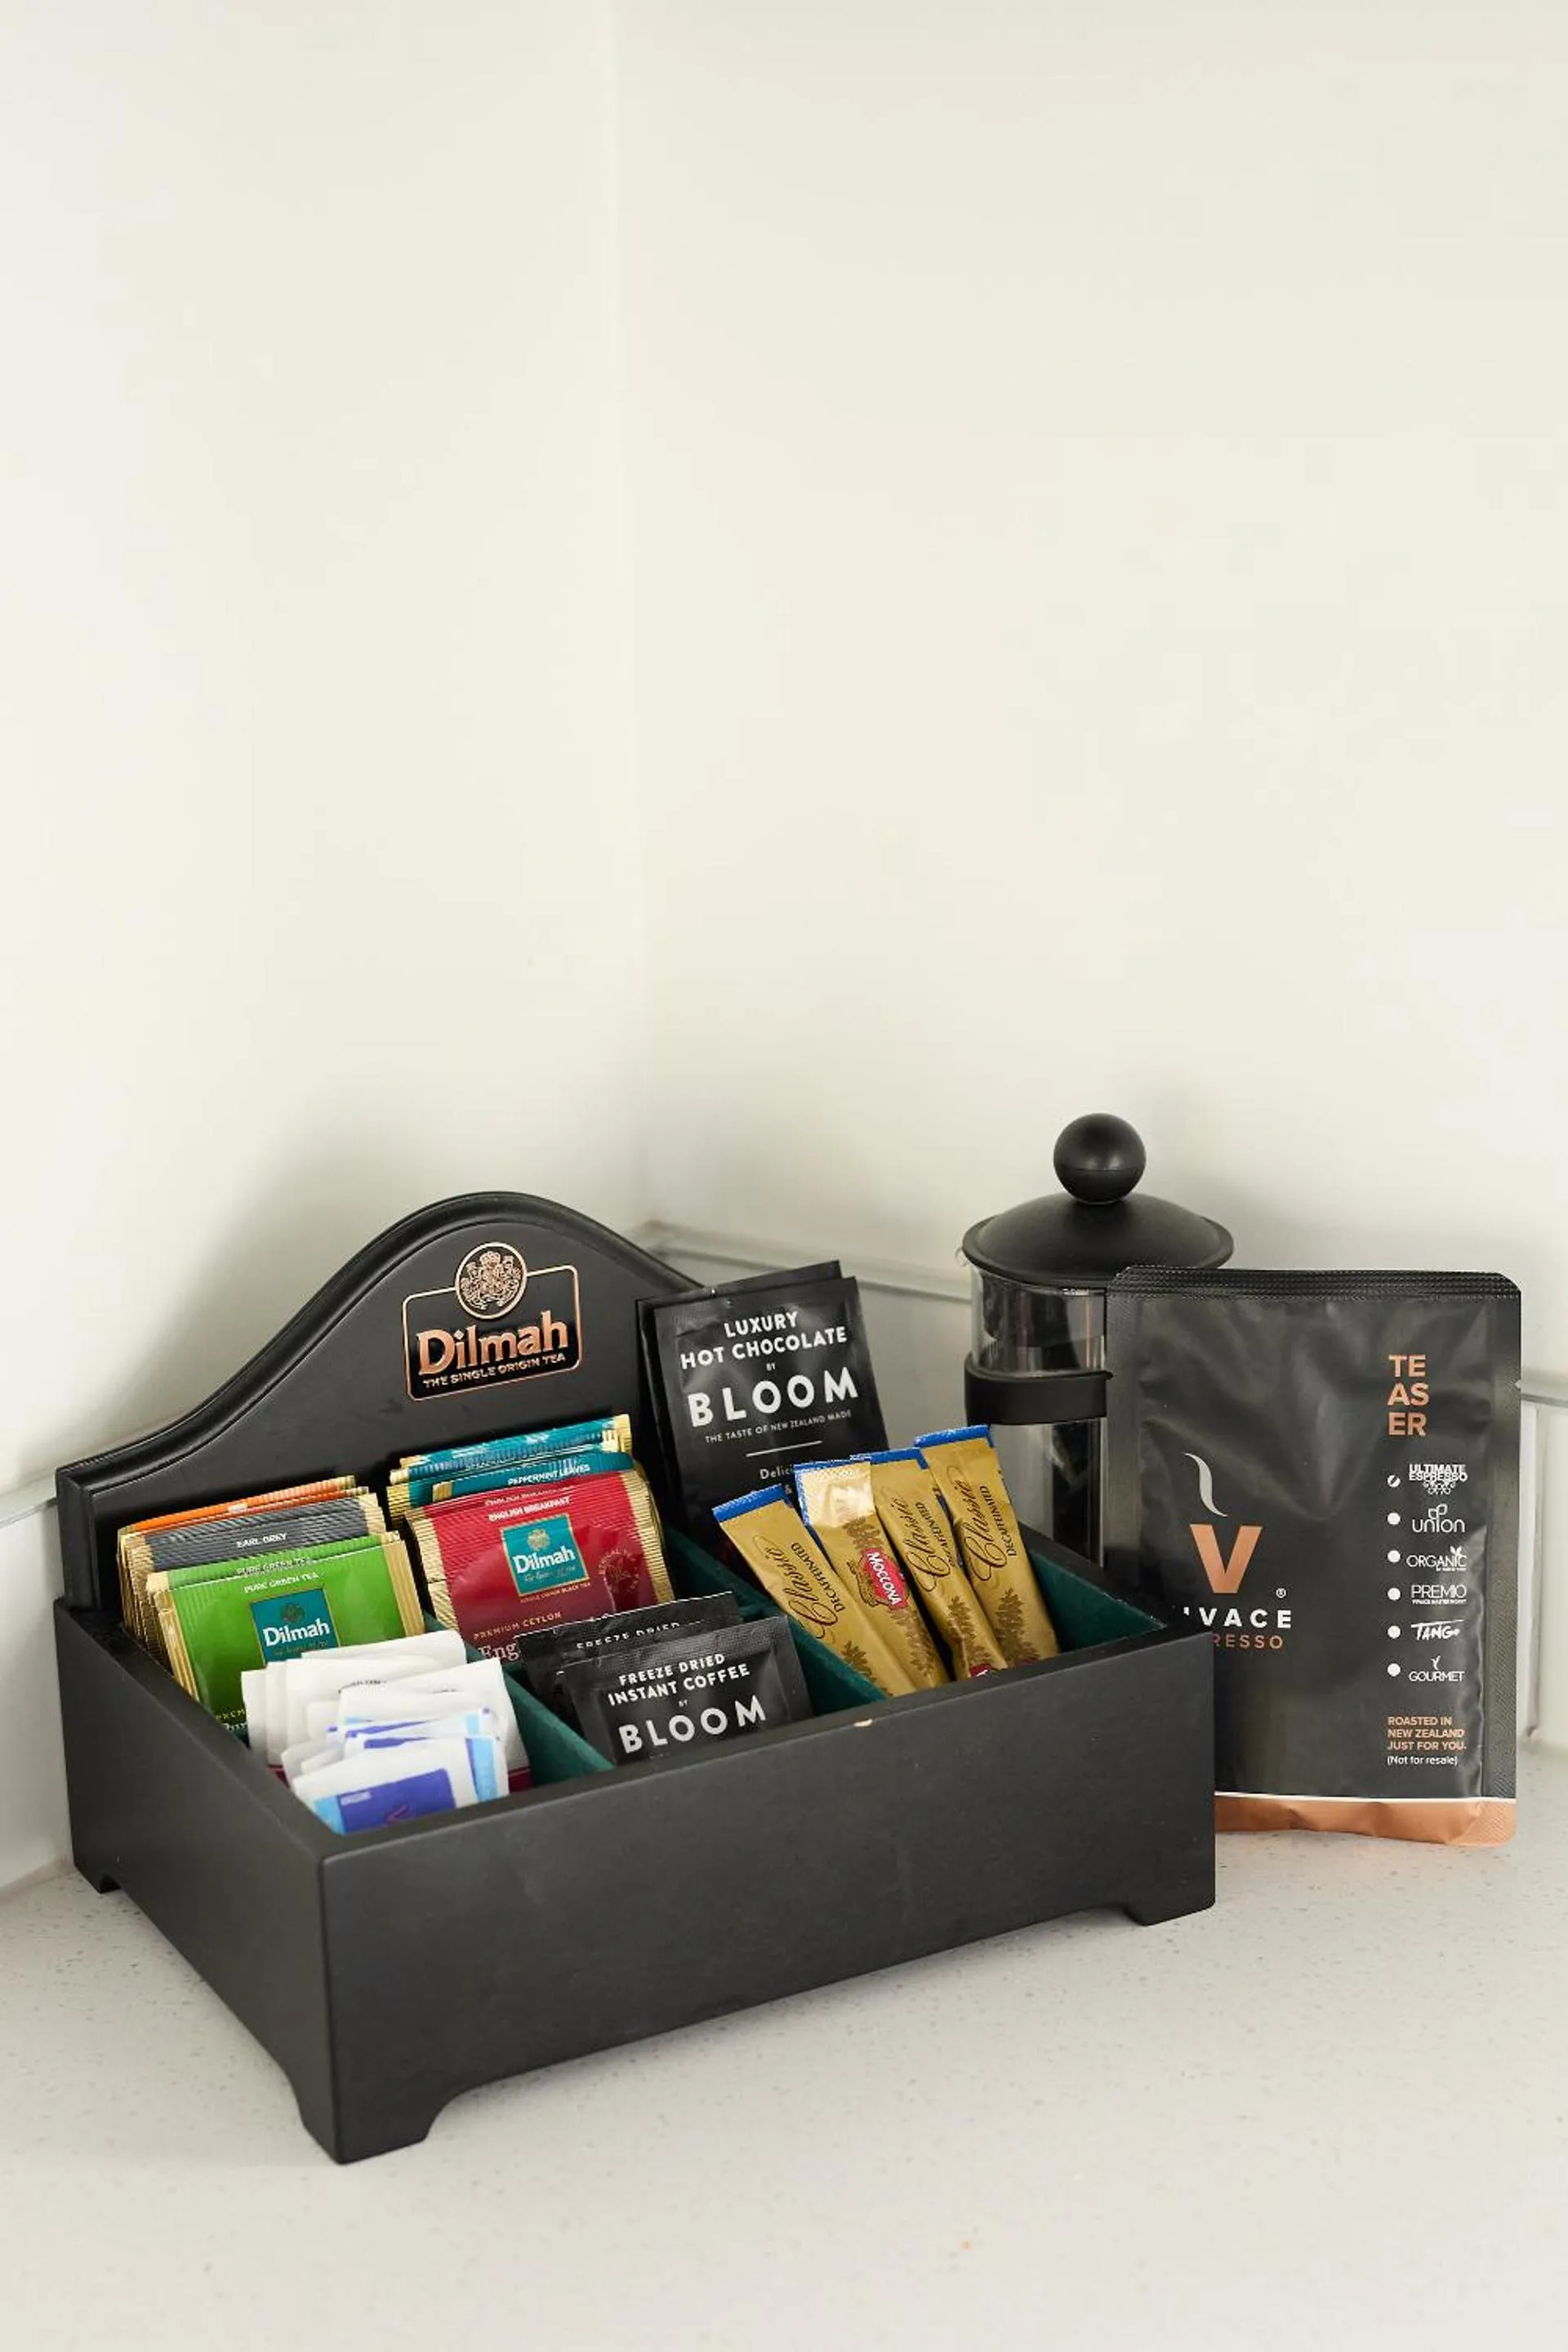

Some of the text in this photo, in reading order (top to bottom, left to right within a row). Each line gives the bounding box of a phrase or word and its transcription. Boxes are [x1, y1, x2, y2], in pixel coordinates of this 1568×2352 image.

[724, 1311, 798, 1338] LUXURY
[416, 1310, 568, 1375] Dilmah
[679, 1325, 848, 1370] HOT CHOCOLATE
[423, 1352, 566, 1388] THE SINGLE ORIGIN TEA
[1388, 1354, 1426, 1378] TE
[687, 1366, 858, 1428] BLOOM
[1387, 1382, 1429, 1406] AS
[705, 1410, 852, 1444] THE TASTE OF NEW ZEALAND MADE
[1388, 1412, 1427, 1437] ER
[507, 1470, 558, 1486] PEPPERMINT
[760, 1464, 794, 1479] Delici
[1409, 1463, 1466, 1472] ULTIMATE
[1409, 1471, 1468, 1482] ESPRESSO
[488, 1508, 523, 1521] ENGLISH
[523, 1495, 572, 1513] BREAKFAST
[1412, 1512, 1465, 1533] union
[236, 1538, 260, 1548] EARL
[512, 1545, 576, 1574] Dilmah
[1189, 1524, 1263, 1593] V
[1406, 1555, 1467, 1567] ORGANIC
[243, 1583, 268, 1593] PURE
[866, 1552, 902, 1605] MOCCONA
[262, 1618, 330, 1647] Dilmah
[1212, 1634, 1283, 1649] RESSO
[478, 1642, 520, 1661] Eng
[618, 1653, 726, 1686] FREEZE DRIED
[1409, 1671, 1465, 1682] GOURMET
[608, 1663, 751, 1707] INSTANT COFFEE
[618, 1695, 766, 1754] BLOOM
[1388, 1716, 1453, 1726] ROASTED IN
[1387, 1741, 1468, 1751] JUST FOR YOU.
[1388, 1729, 1465, 1739] NEW ZEALAND
[1387, 1755, 1458, 1766] (Not for resale)
